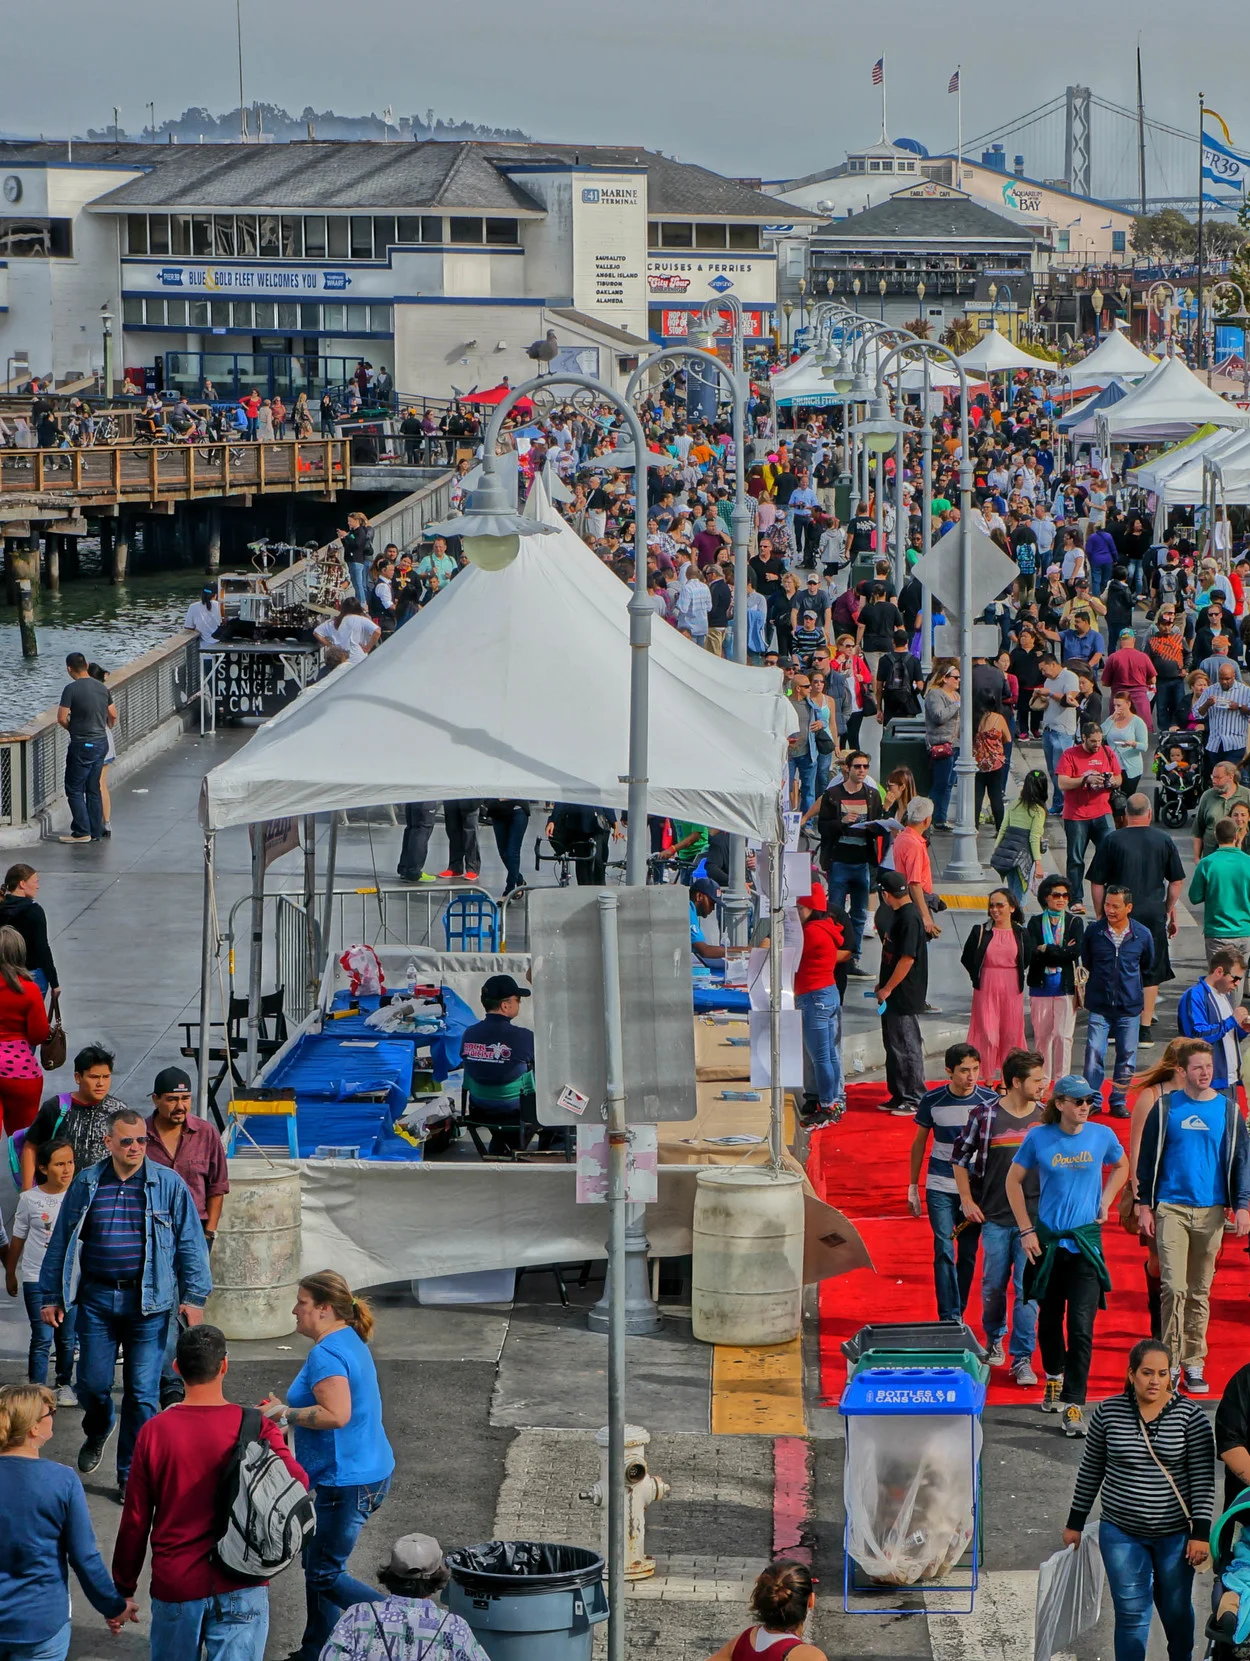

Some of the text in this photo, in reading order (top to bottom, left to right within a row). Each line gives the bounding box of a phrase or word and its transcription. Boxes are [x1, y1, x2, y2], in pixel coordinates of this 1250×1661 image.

[587, 190, 598, 201] 41
[601, 189, 638, 198] MARINE
[1019, 199, 1041, 211] BAY
[647, 263, 692, 271] CRUISES
[708, 264, 752, 272] FERRIES
[189, 271, 206, 285] BLUE
[214, 272, 232, 286] GOLD
[235, 272, 254, 287] FLEET
[257, 272, 299, 288] WELCOMES
[302, 273, 317, 288] YOU
[791, 396, 820, 405] CRUNCH
[1052, 1151, 1093, 1167] Powell's
[877, 1390, 932, 1398] BOTTLES
